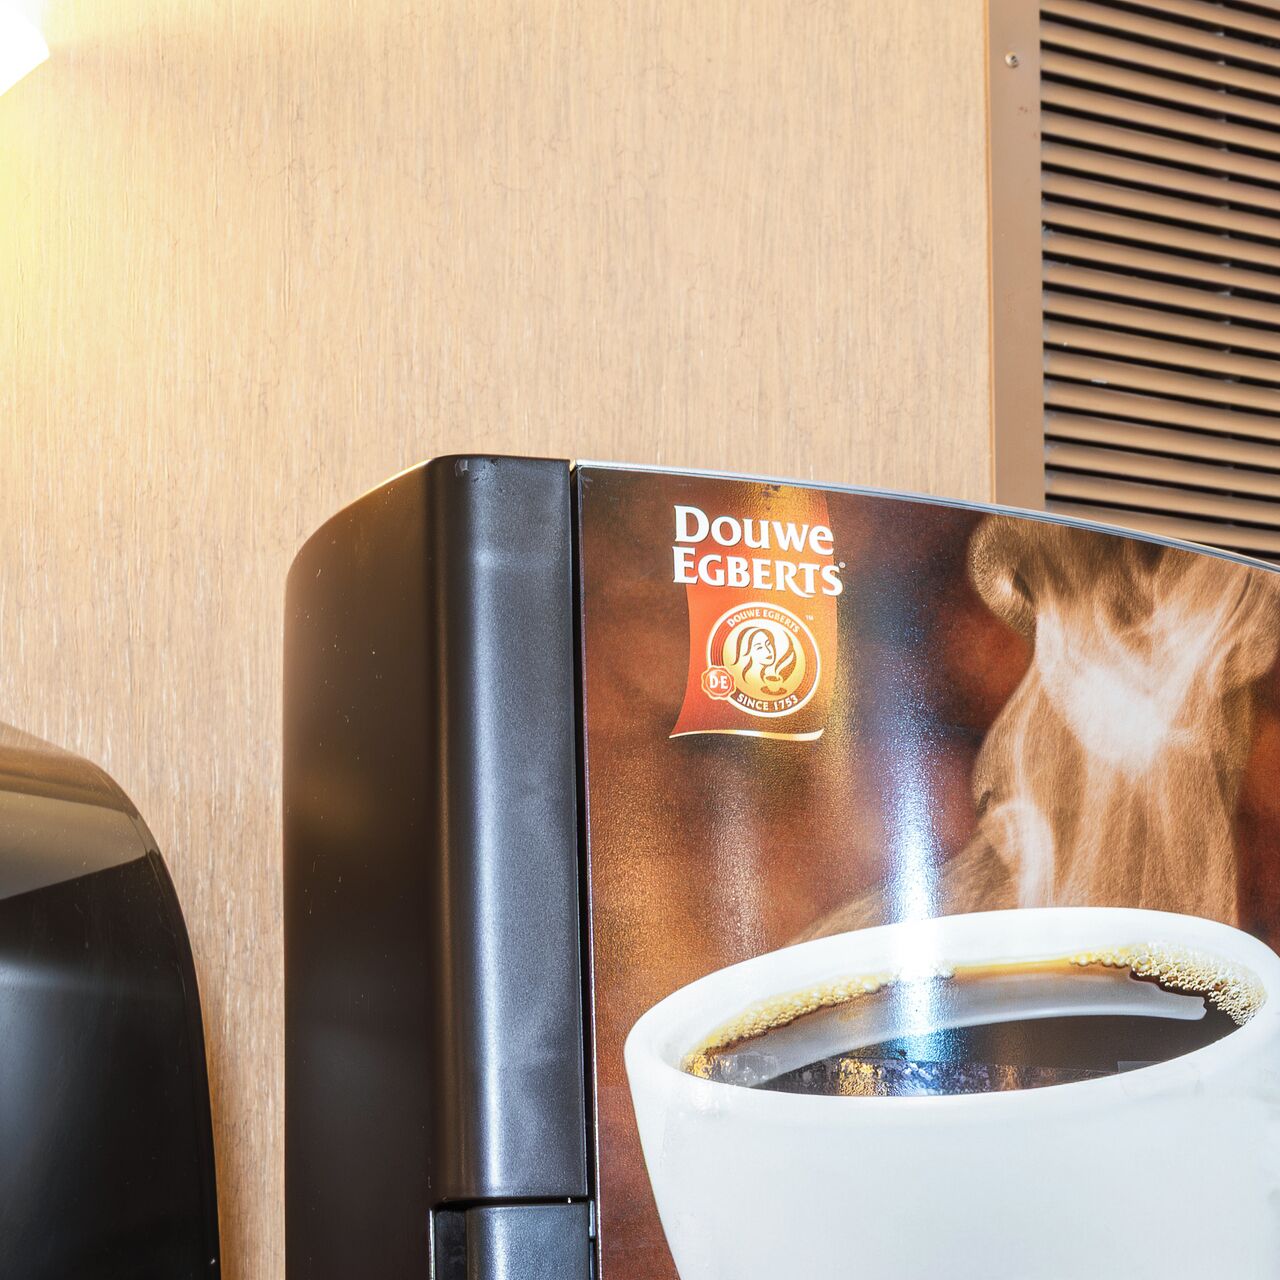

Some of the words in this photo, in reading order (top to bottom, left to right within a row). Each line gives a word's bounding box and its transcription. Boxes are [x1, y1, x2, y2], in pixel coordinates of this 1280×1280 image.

[672, 546, 843, 598] EGBERTS
[727, 609, 761, 628] DOUWE
[763, 609, 800, 633] EGBERTS
[737, 694, 769, 711] SINCE
[773, 694, 799, 711] 1753
